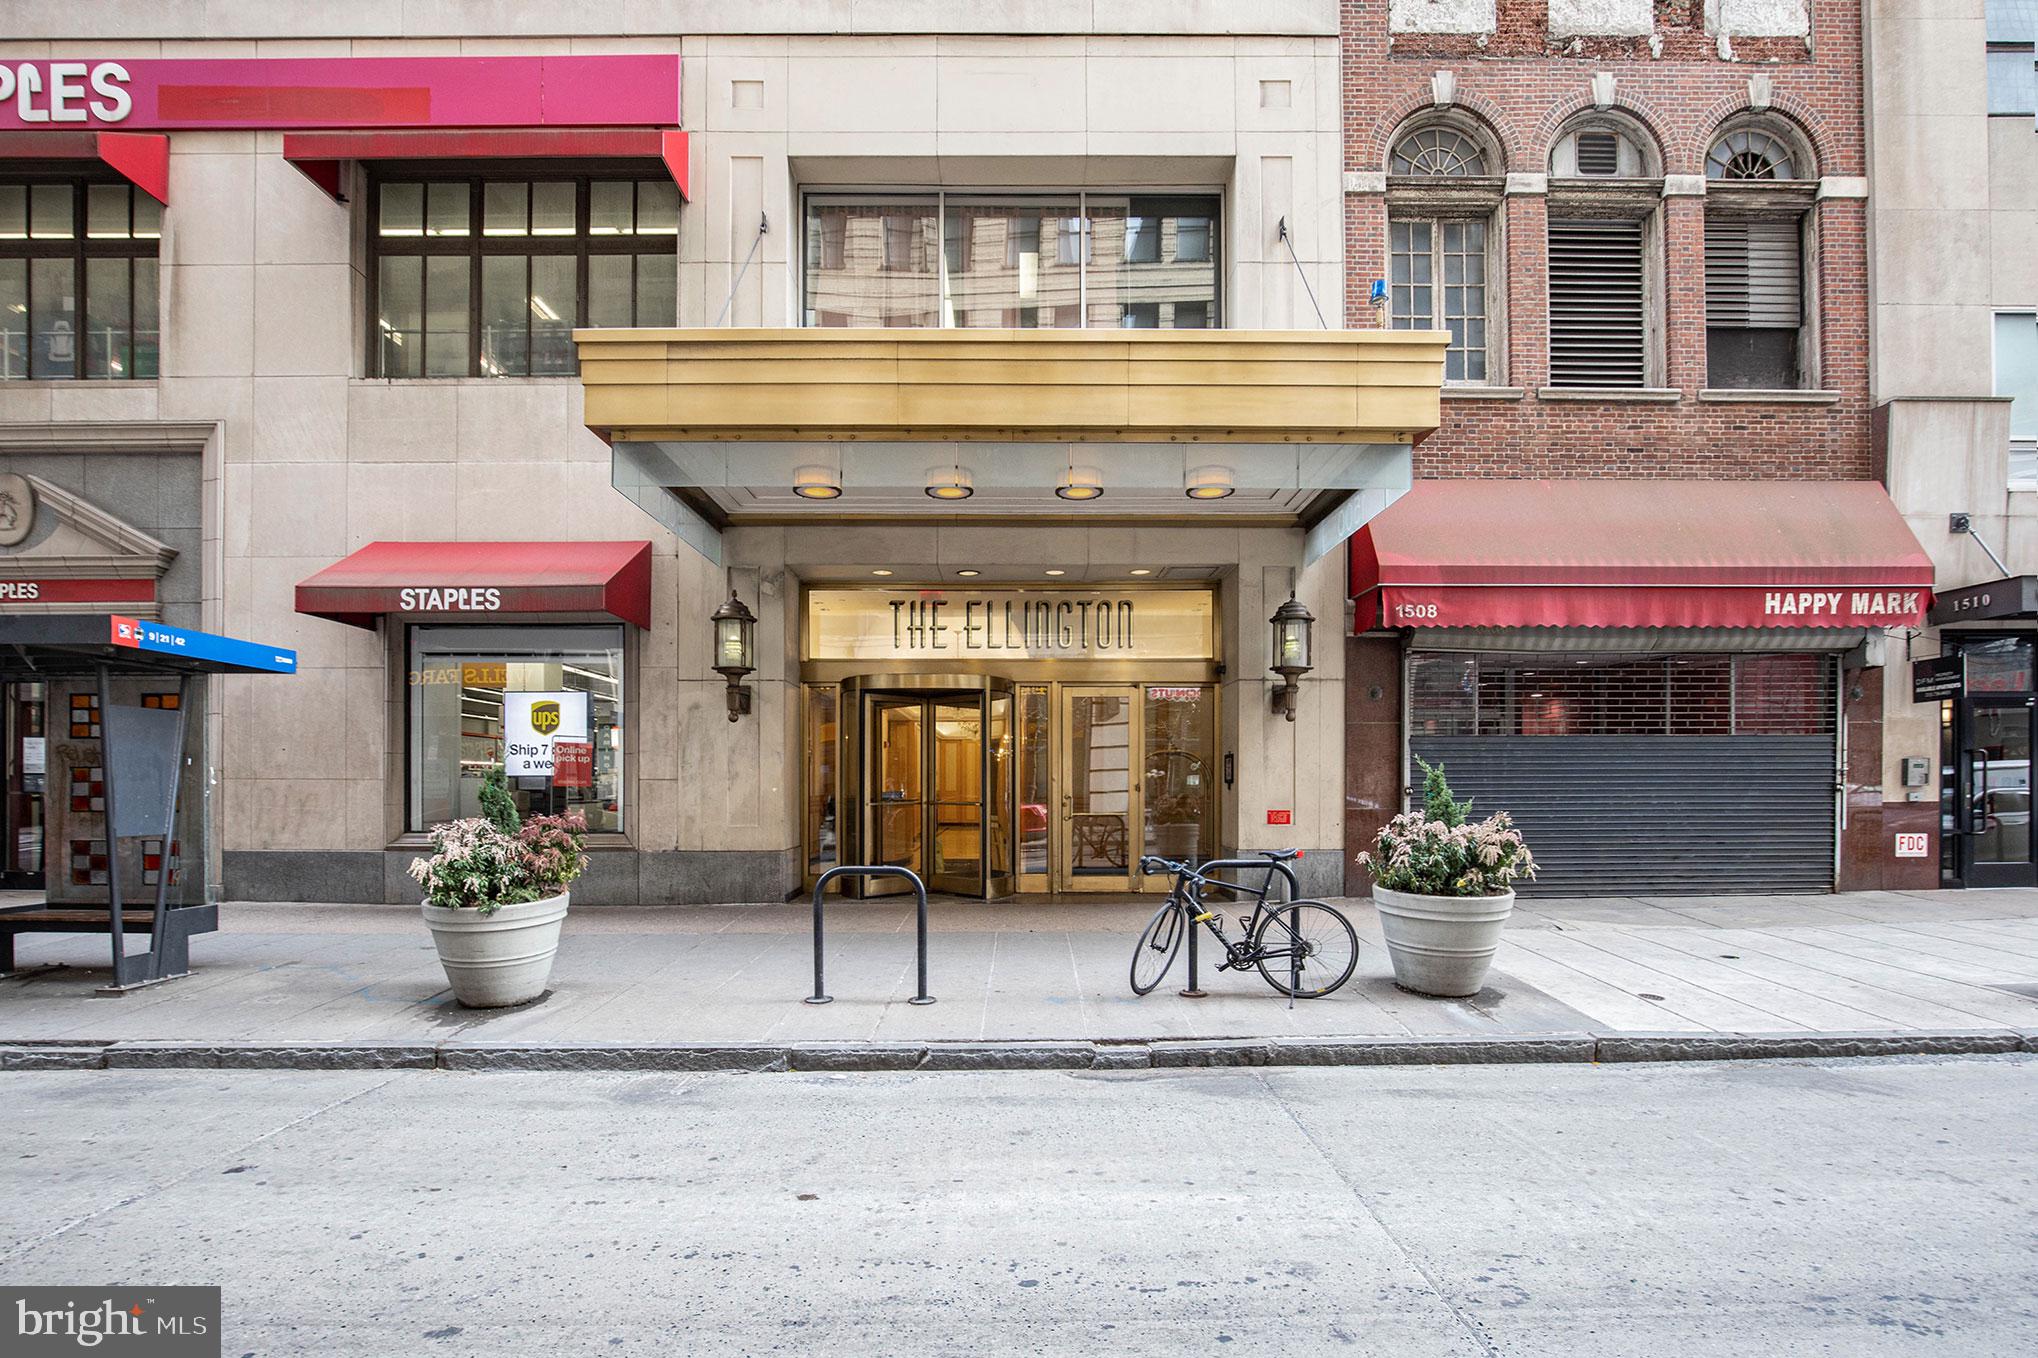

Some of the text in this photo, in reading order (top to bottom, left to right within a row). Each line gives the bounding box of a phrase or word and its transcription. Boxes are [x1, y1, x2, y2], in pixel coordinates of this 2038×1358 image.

[400, 588, 500, 610] STAPLES
[1765, 592, 1919, 614] HAPPY MARK
[1953, 594, 1990, 612] 1510
[1396, 604, 1438, 618] 1508
[889, 599, 1134, 648] THE ELLINGTON
[533, 711, 559, 730] ups
[510, 744, 538, 758] Ship
[541, 744, 549, 755] 7
[556, 745, 587, 754] Online
[556, 755, 576, 763] pick
[1899, 836, 1923, 850] FDC
